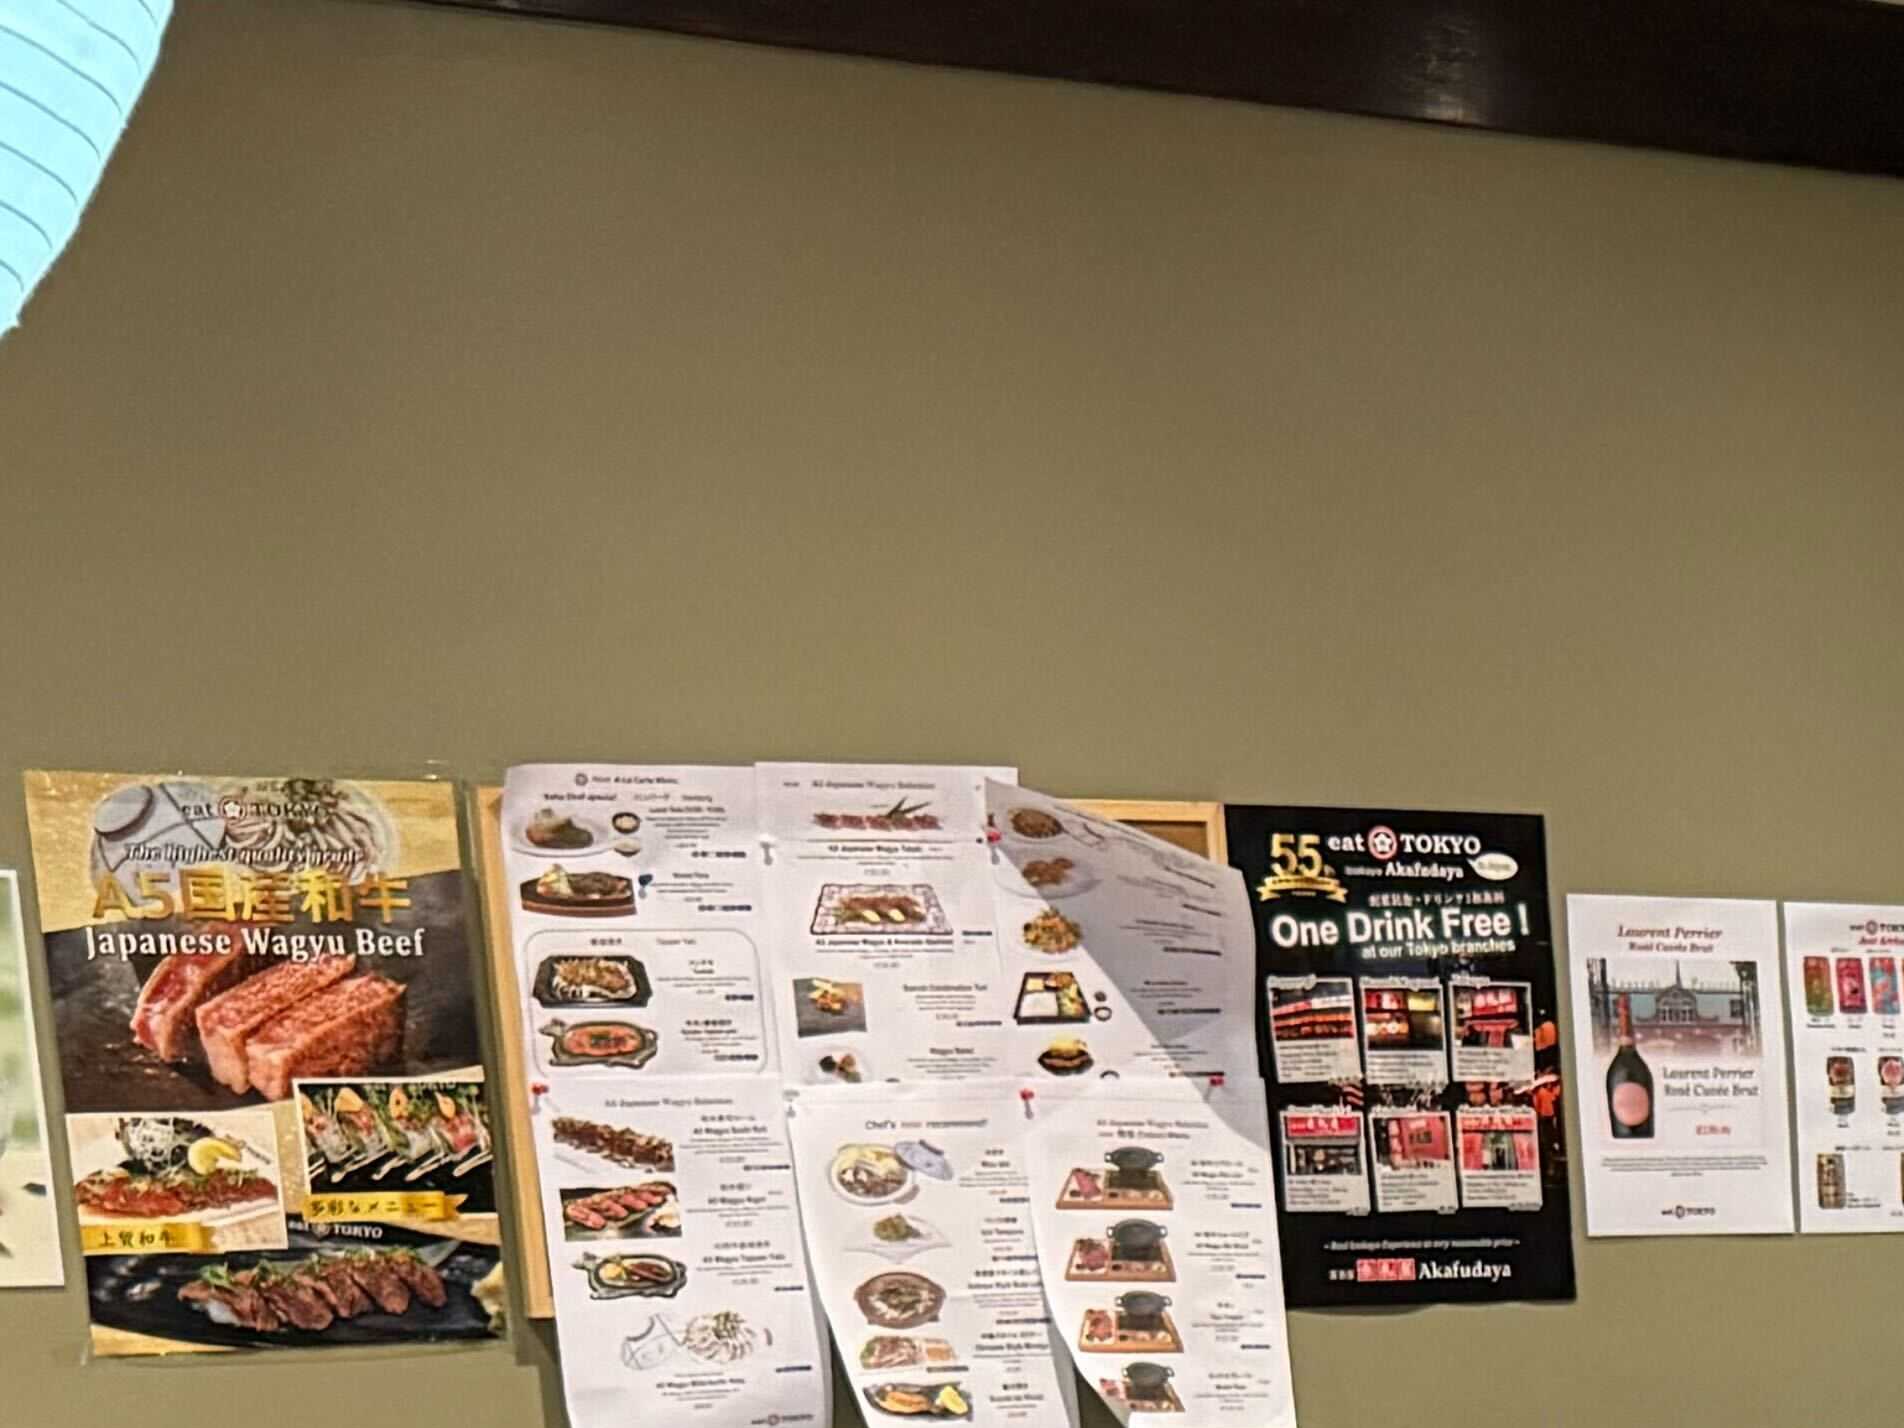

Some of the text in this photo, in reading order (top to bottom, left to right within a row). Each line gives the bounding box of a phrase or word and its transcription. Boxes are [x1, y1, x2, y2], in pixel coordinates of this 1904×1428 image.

[1327, 834, 1481, 855] eat TOKYO
[1271, 913, 1339, 948] One
[1346, 908, 1434, 943] Drink
[1440, 906, 1512, 939] Free
[86, 927, 425, 961] Japanese Wagyu Beef
[1379, 945, 1403, 958] our
[1405, 942, 1449, 958] Tokyo
[1451, 937, 1516, 956] branches
[1663, 1067, 1754, 1080] Laurent Perrier
[1419, 1260, 1511, 1282] Akafudaya
